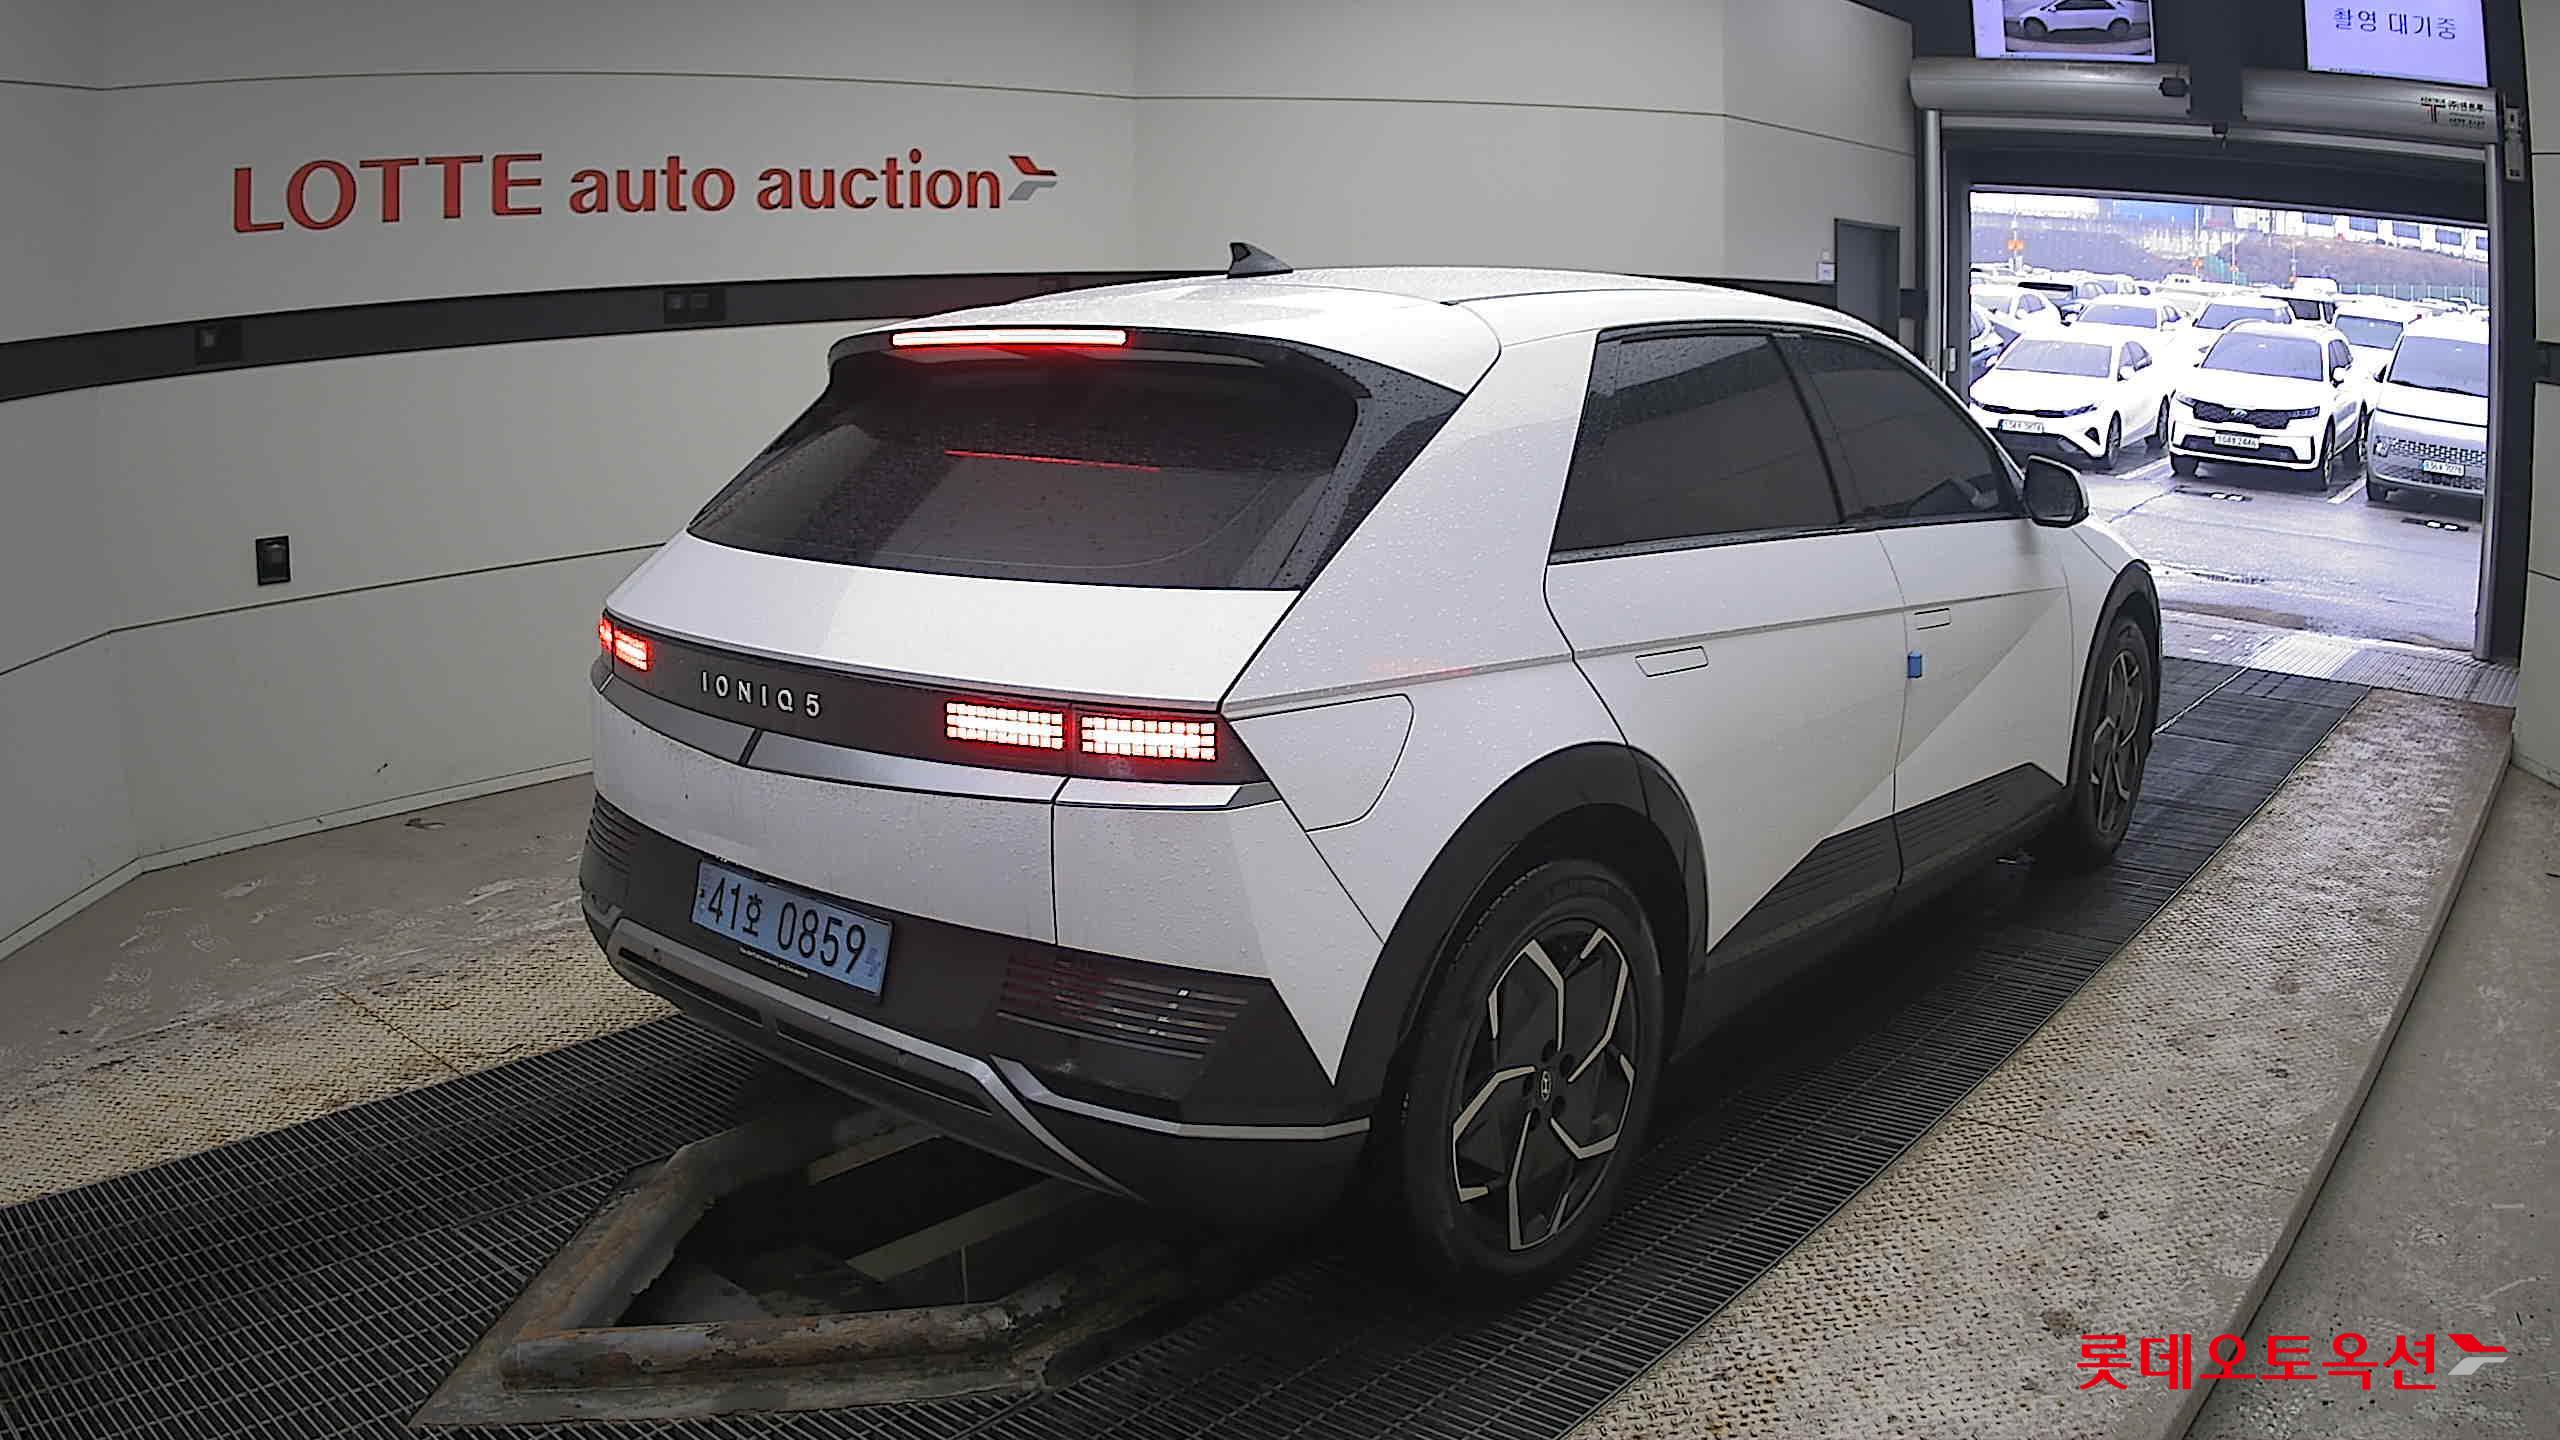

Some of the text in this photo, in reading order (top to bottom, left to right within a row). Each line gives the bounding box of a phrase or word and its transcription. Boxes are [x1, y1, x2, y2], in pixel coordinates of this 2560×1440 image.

[2388, 12, 2457, 40] 대기중
[233, 147, 1002, 234] LOTTE auto auction
[701, 671, 821, 717] IONIQ 5
[707, 876, 867, 975] 41호 0859
